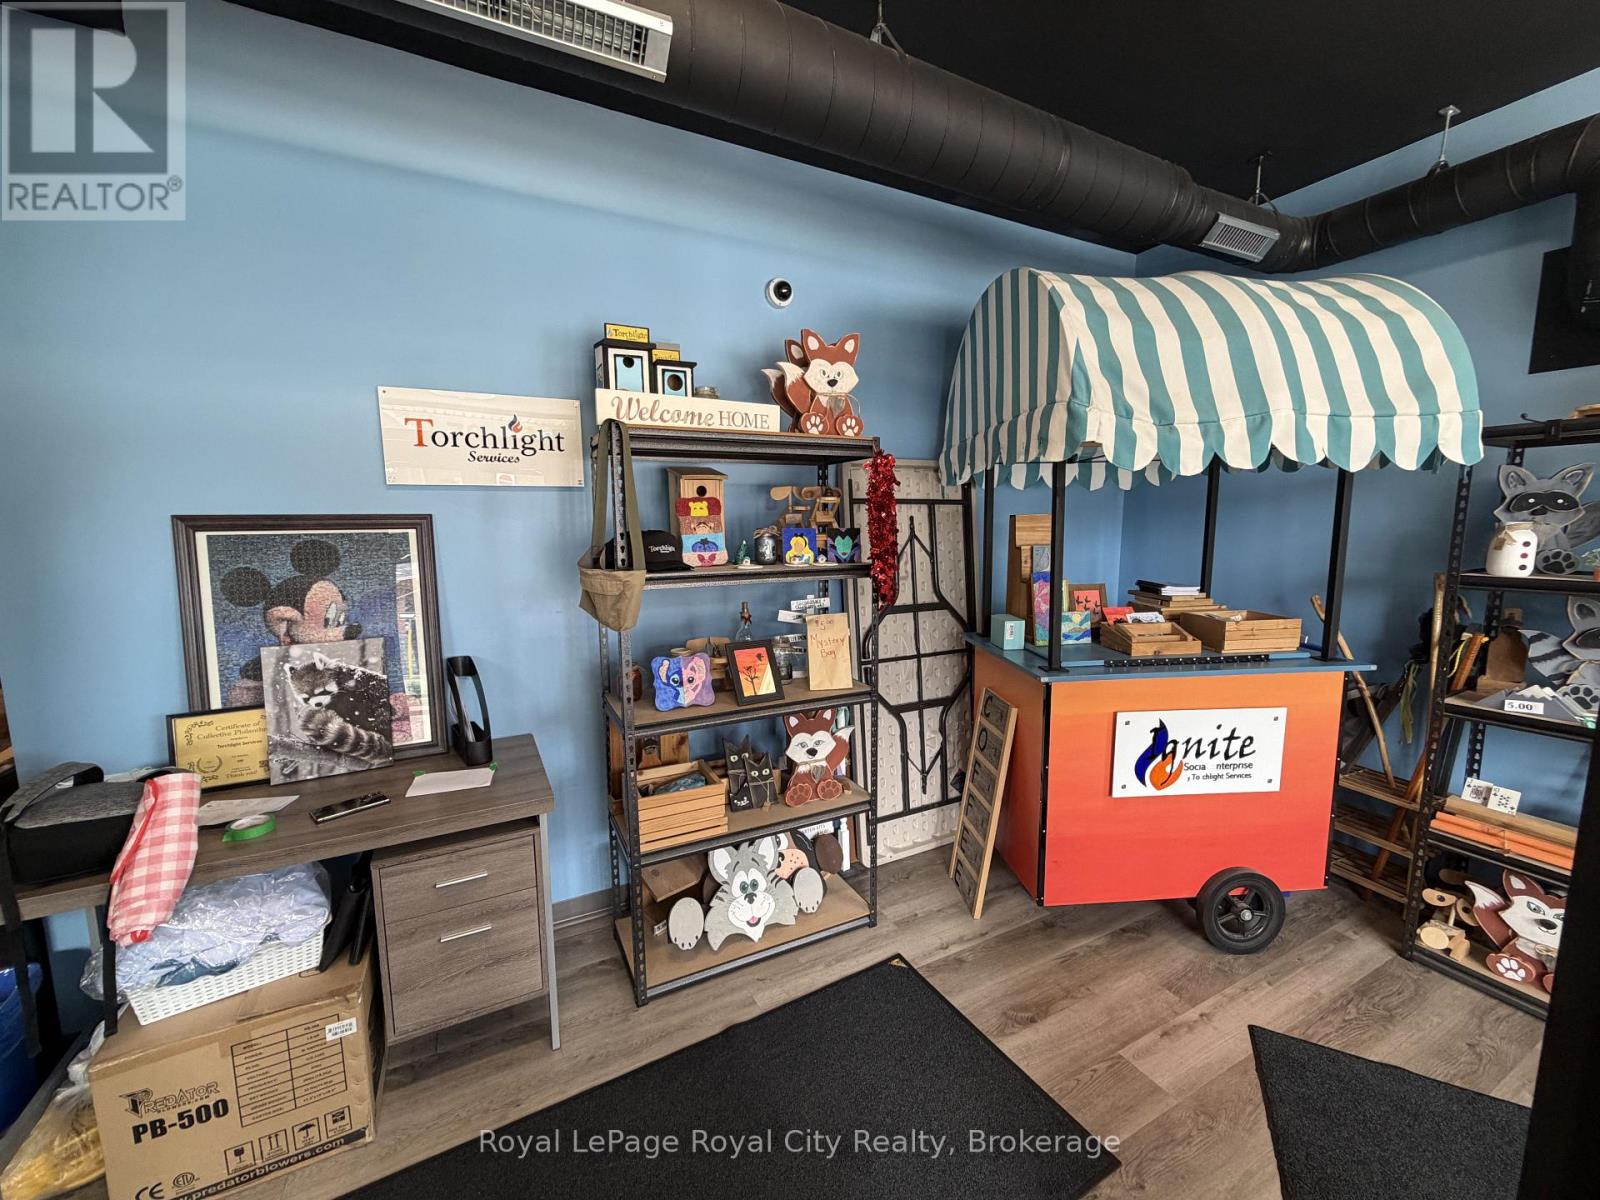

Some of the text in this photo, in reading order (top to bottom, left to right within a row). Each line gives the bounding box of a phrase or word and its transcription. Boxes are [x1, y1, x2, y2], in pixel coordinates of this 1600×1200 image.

[610, 395, 770, 430] Welcome HOME
[404, 417, 565, 457] Torchlight
[467, 450, 520, 464] Services
[820, 648, 837, 659] Bag
[1507, 702, 1533, 711] 5.00
[1226, 771, 1252, 780] Services
[118, 1081, 220, 1118] PREDATOR
[132, 1098, 229, 1145] PB-500
